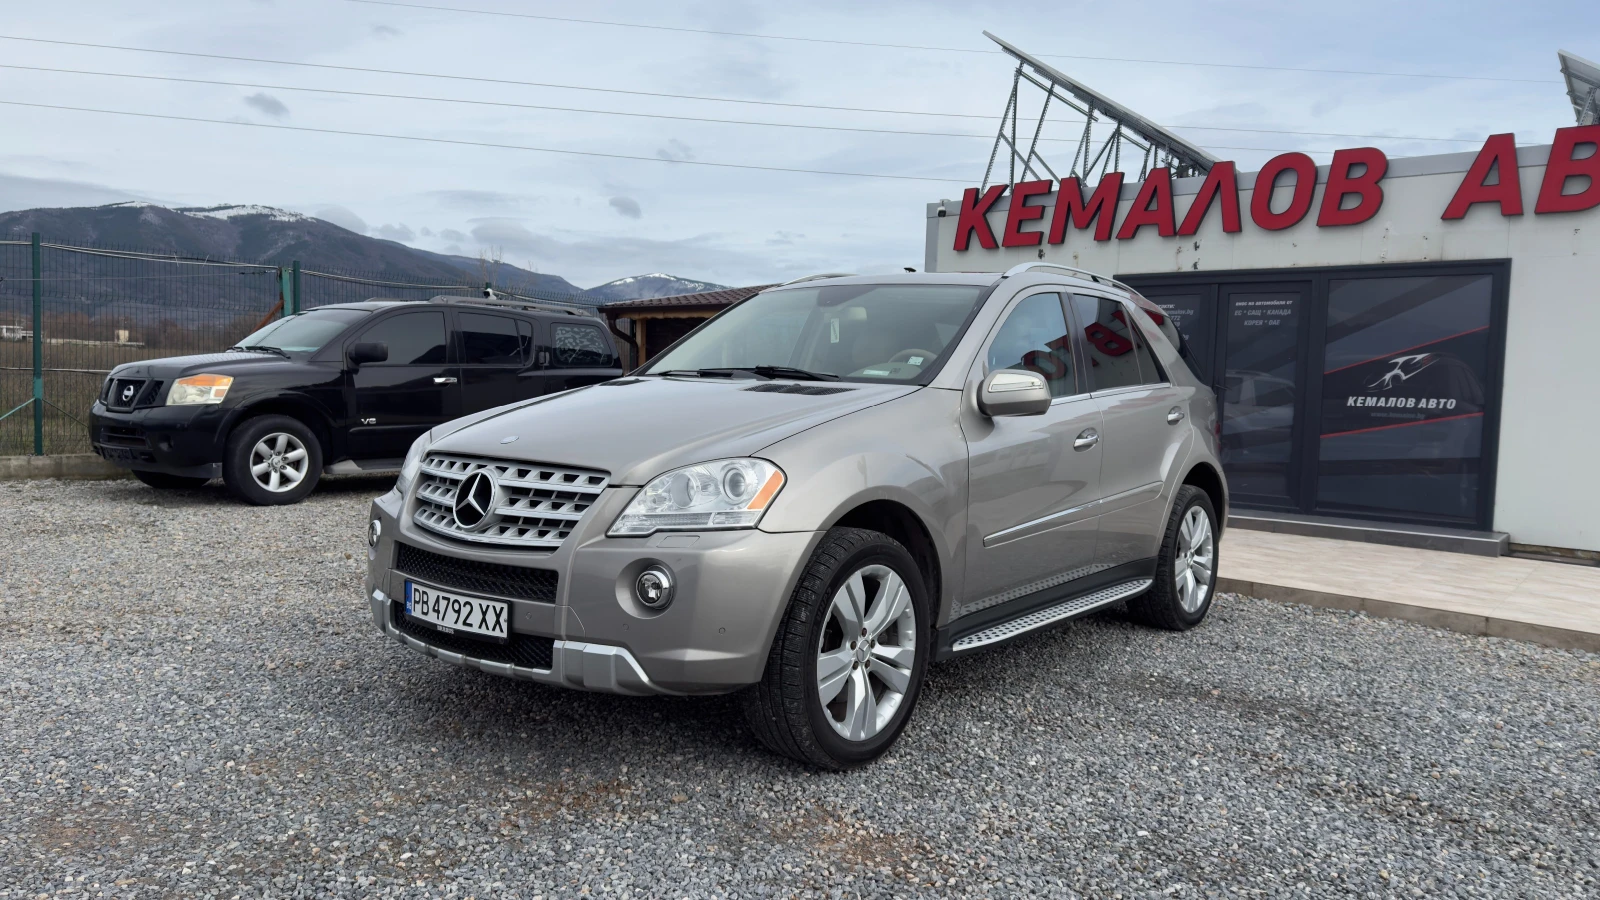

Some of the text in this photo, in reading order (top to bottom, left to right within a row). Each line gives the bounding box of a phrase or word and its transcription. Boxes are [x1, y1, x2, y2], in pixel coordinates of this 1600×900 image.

[953, 124, 1600, 251] КЕМАЛОВ АВ
[1266, 308, 1291, 316] КАНАДА
[1346, 396, 1457, 410] КЕМАЛОВ АВТО
[432, 594, 474, 628] 4792
